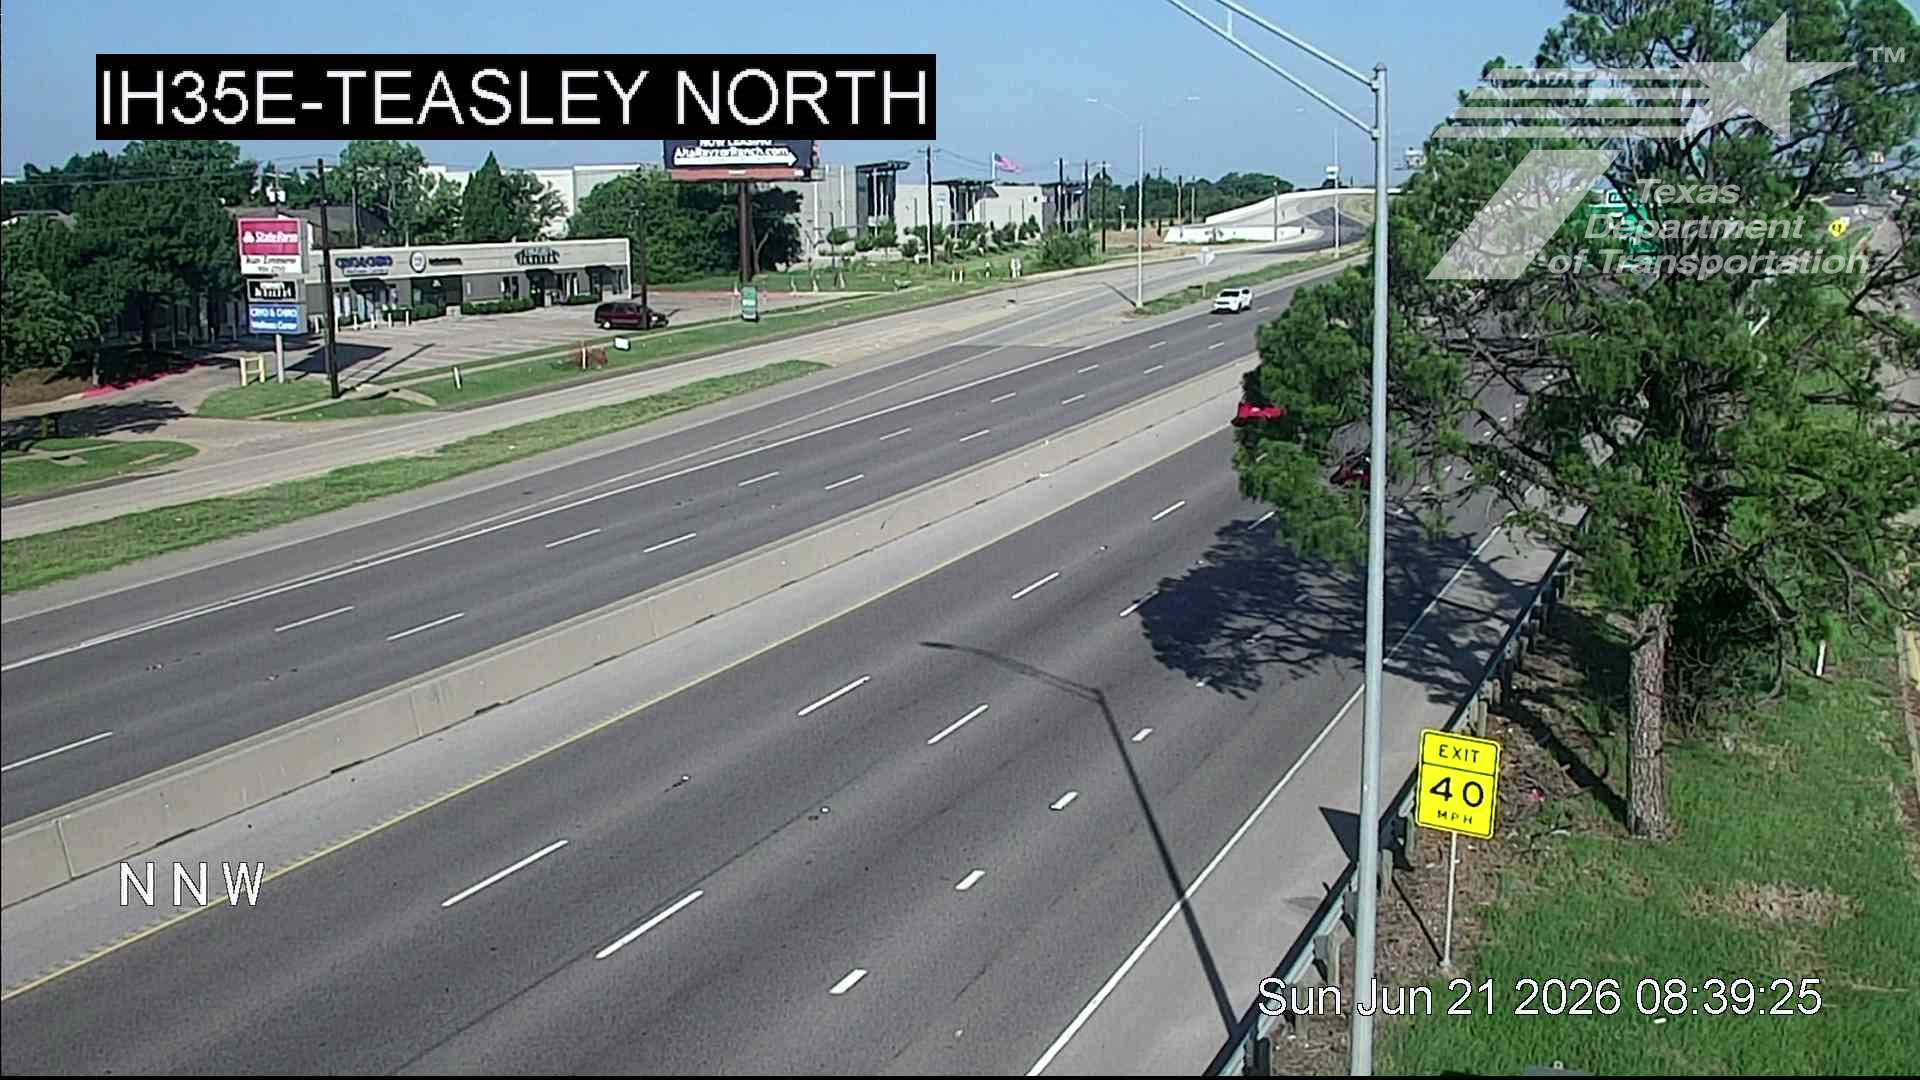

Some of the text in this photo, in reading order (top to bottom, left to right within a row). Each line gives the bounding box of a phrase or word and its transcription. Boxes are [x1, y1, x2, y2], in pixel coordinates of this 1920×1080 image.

[1438, 744, 1480, 763] EXIT
[1430, 776, 1484, 807] 40
[1437, 810, 1473, 824] MPH
